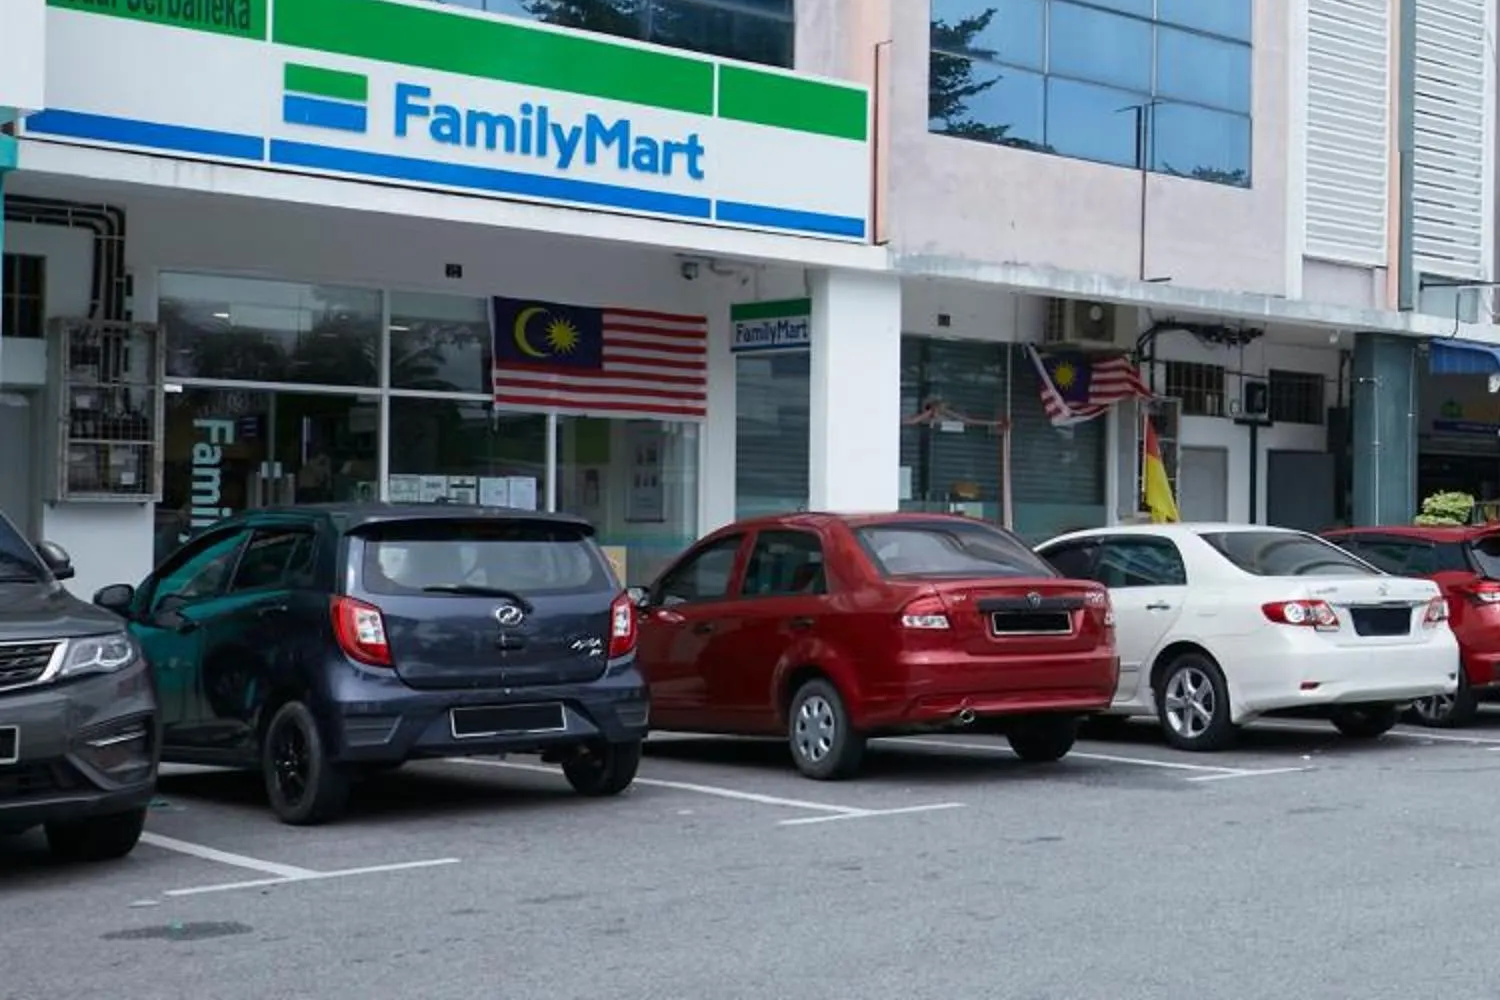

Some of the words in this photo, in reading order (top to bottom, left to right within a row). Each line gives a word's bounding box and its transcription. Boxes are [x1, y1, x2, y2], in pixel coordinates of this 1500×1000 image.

[394, 81, 705, 180] FamilyMart
[735, 319, 809, 344] FamilyMart
[182, 418, 235, 543] Famil
